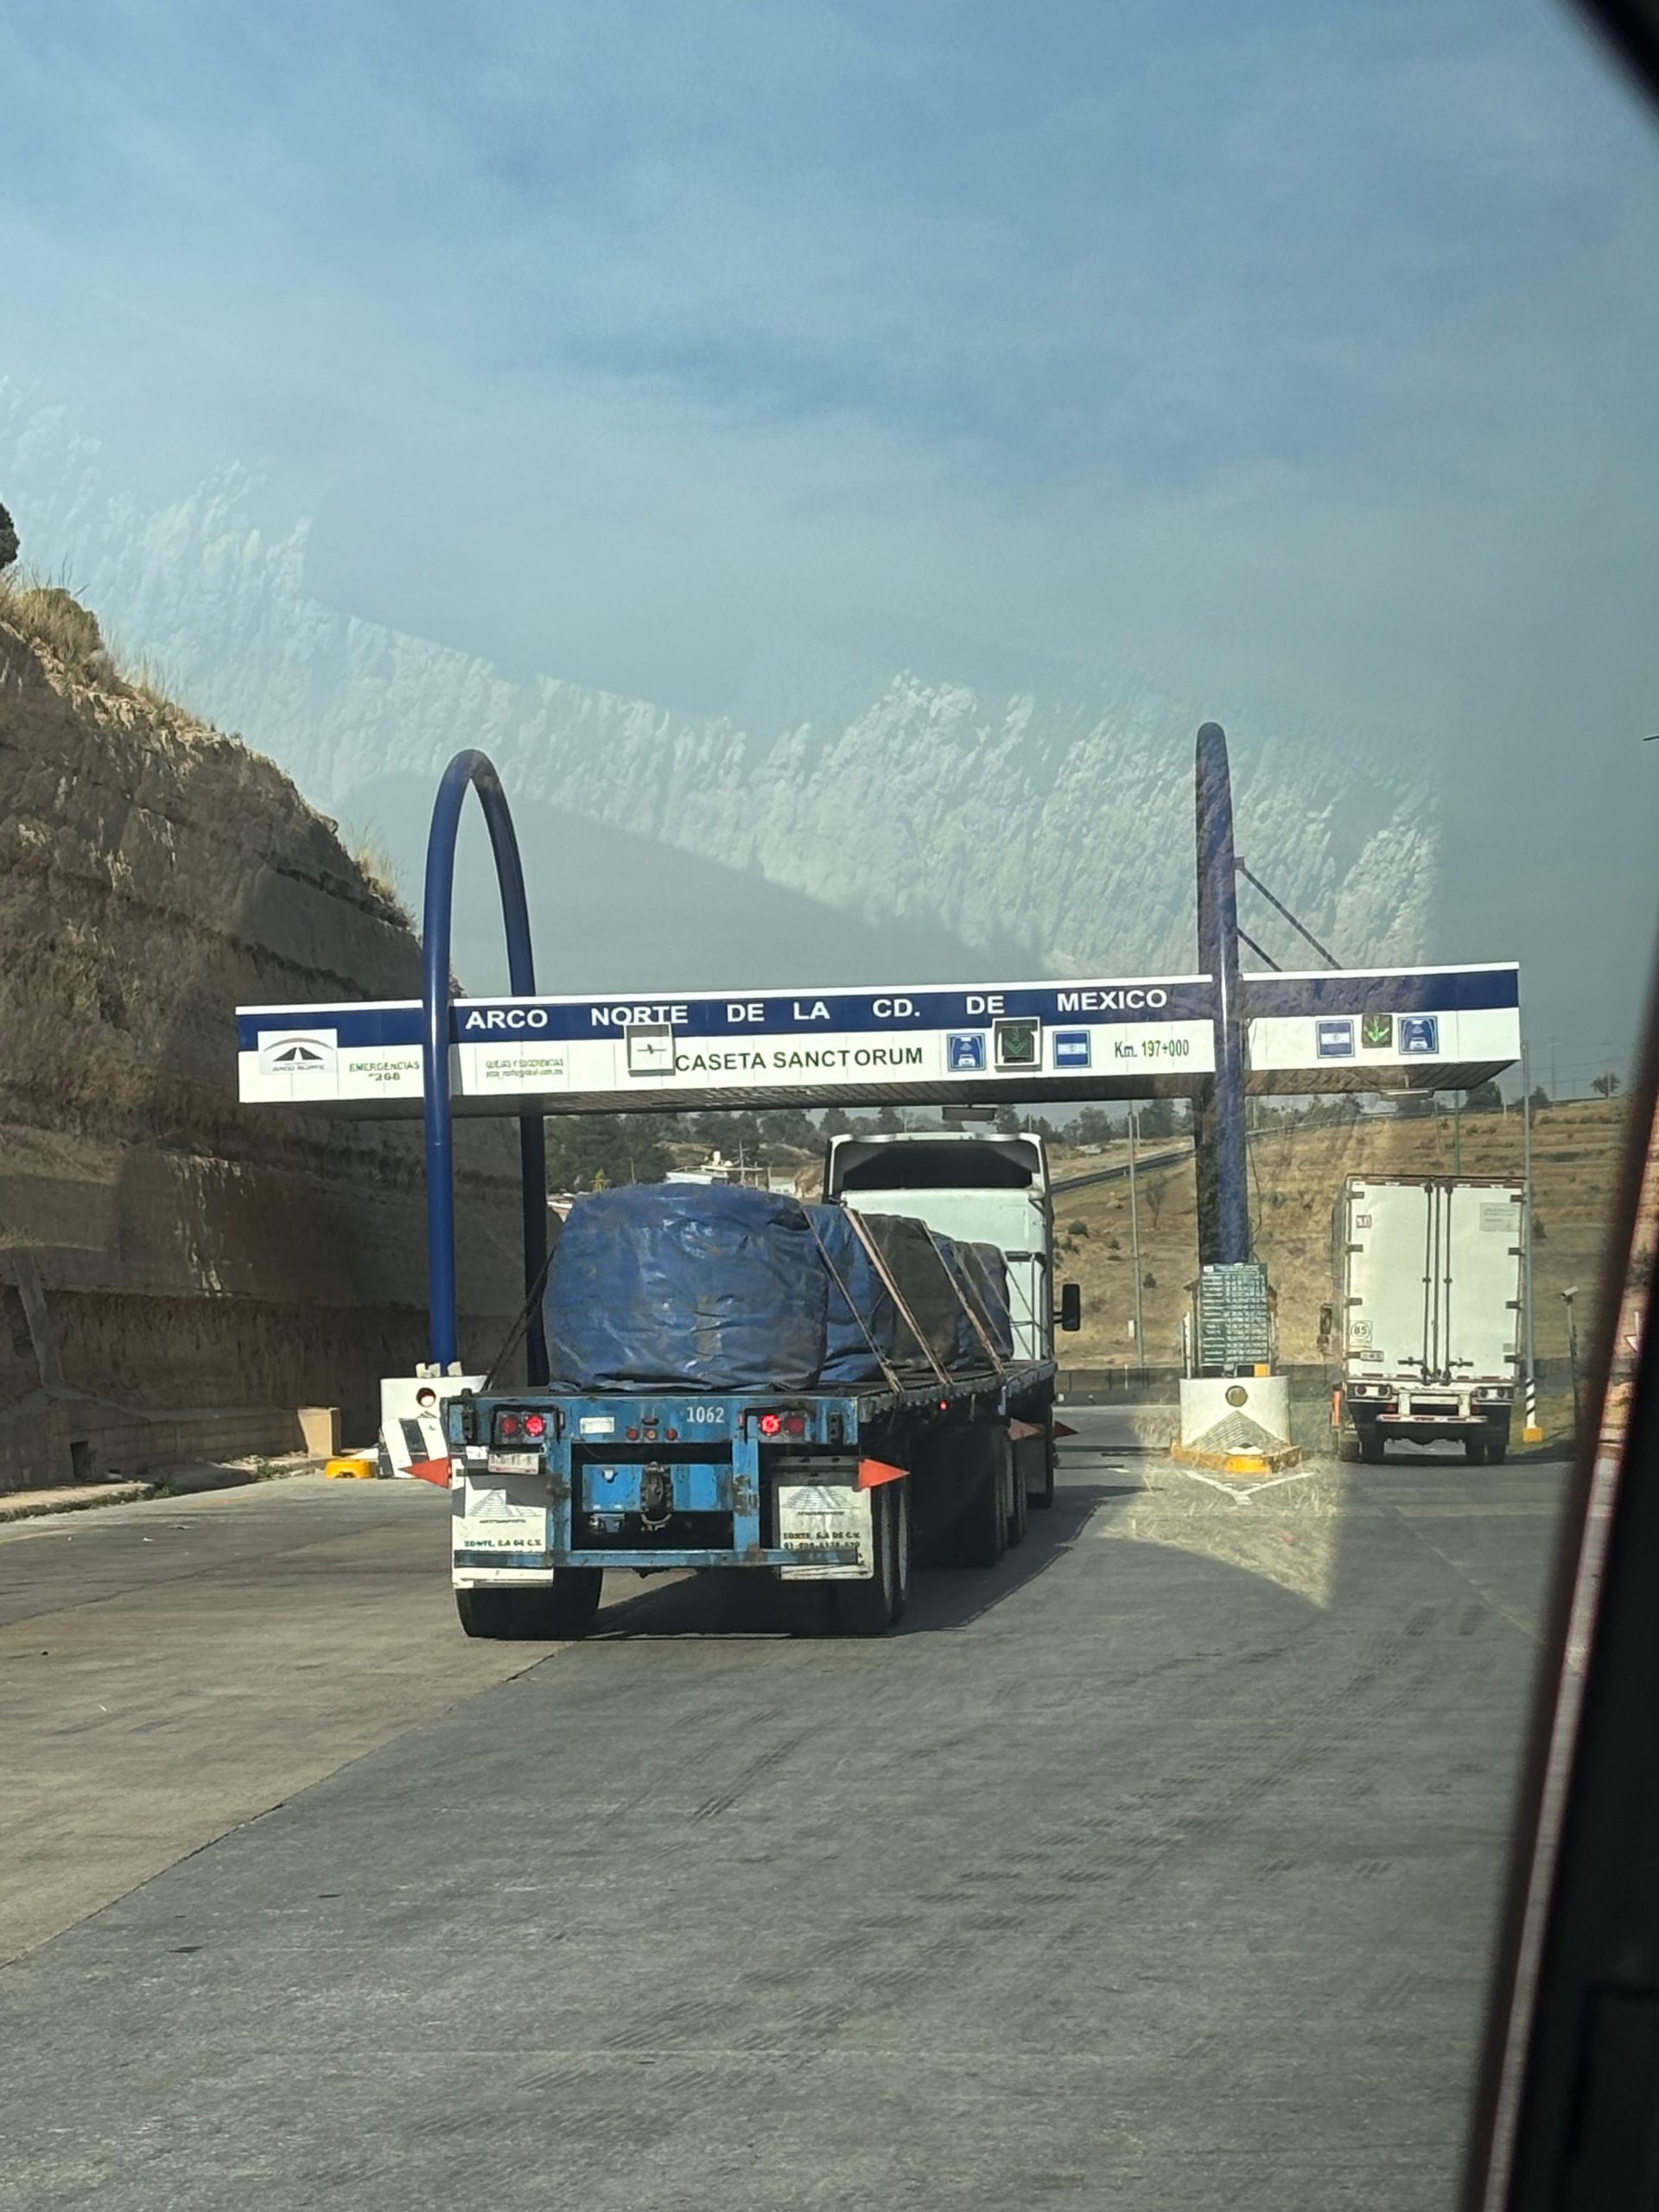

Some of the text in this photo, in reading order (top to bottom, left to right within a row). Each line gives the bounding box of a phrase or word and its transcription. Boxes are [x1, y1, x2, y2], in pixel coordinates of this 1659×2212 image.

[465, 988, 1167, 1029] ARCO NORTE DE LA CD. DE MEXICO
[349, 1061, 420, 1072] EMERGENCIAS
[675, 1046, 923, 1072] CASETA SANCTORUM
[686, 1406, 724, 1423] 1062
